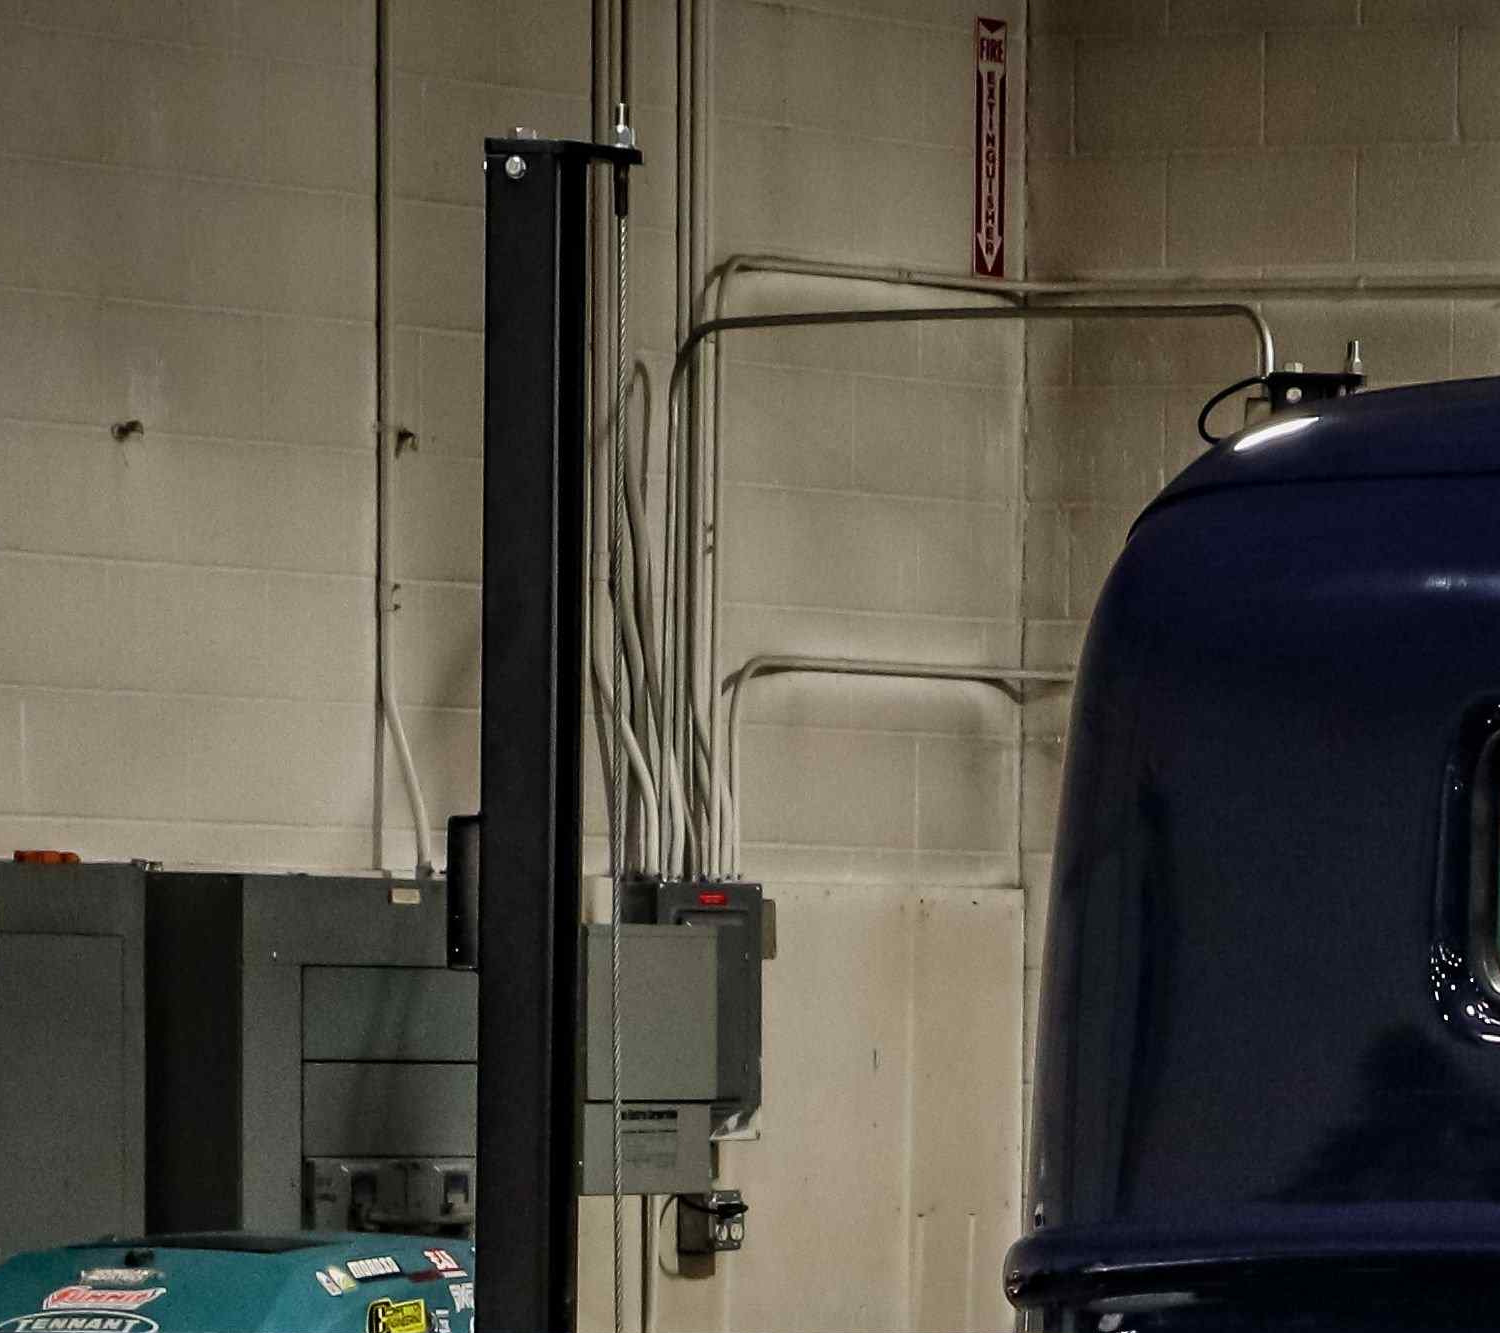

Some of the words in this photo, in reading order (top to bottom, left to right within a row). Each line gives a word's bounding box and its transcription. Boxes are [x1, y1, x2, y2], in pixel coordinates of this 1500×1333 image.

[980, 37, 1004, 64] FIRE
[984, 70, 1000, 256] EXTINGUISHER
[14, 1317, 142, 1332] TENNANT
